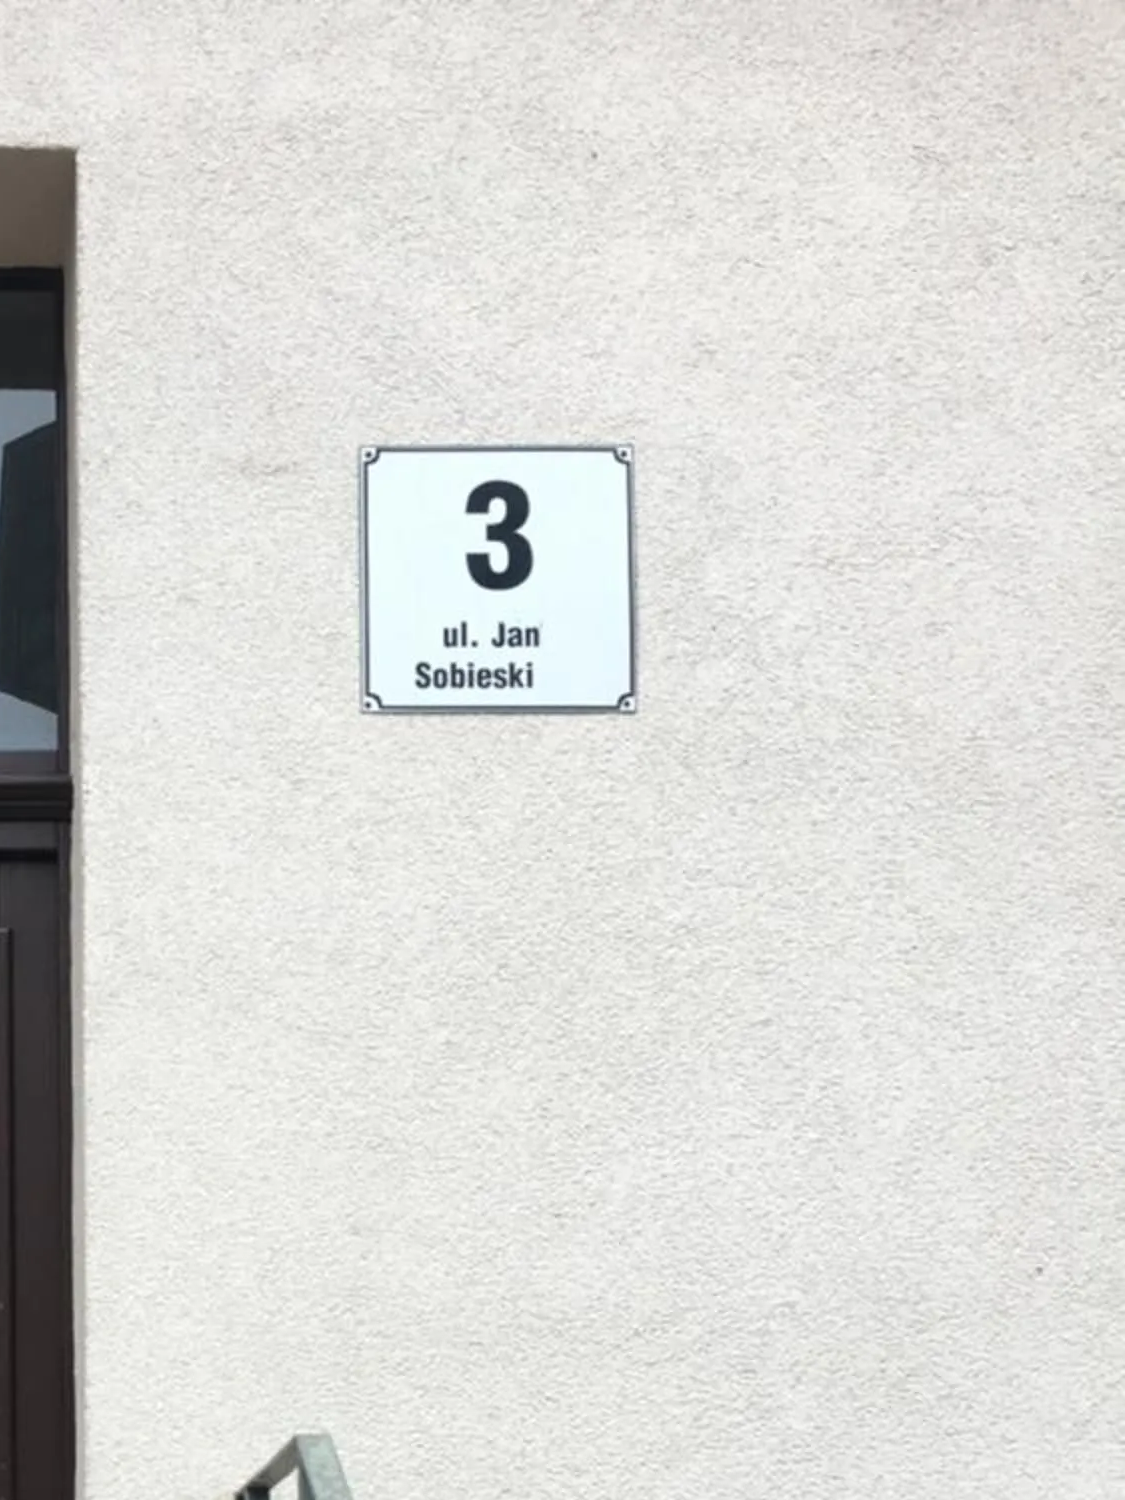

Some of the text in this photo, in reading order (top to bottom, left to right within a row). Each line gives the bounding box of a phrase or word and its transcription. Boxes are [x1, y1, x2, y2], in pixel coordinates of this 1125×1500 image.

[465, 479, 534, 591] 3
[442, 621, 541, 648] ul. Jan
[414, 661, 534, 689] Sobieski
